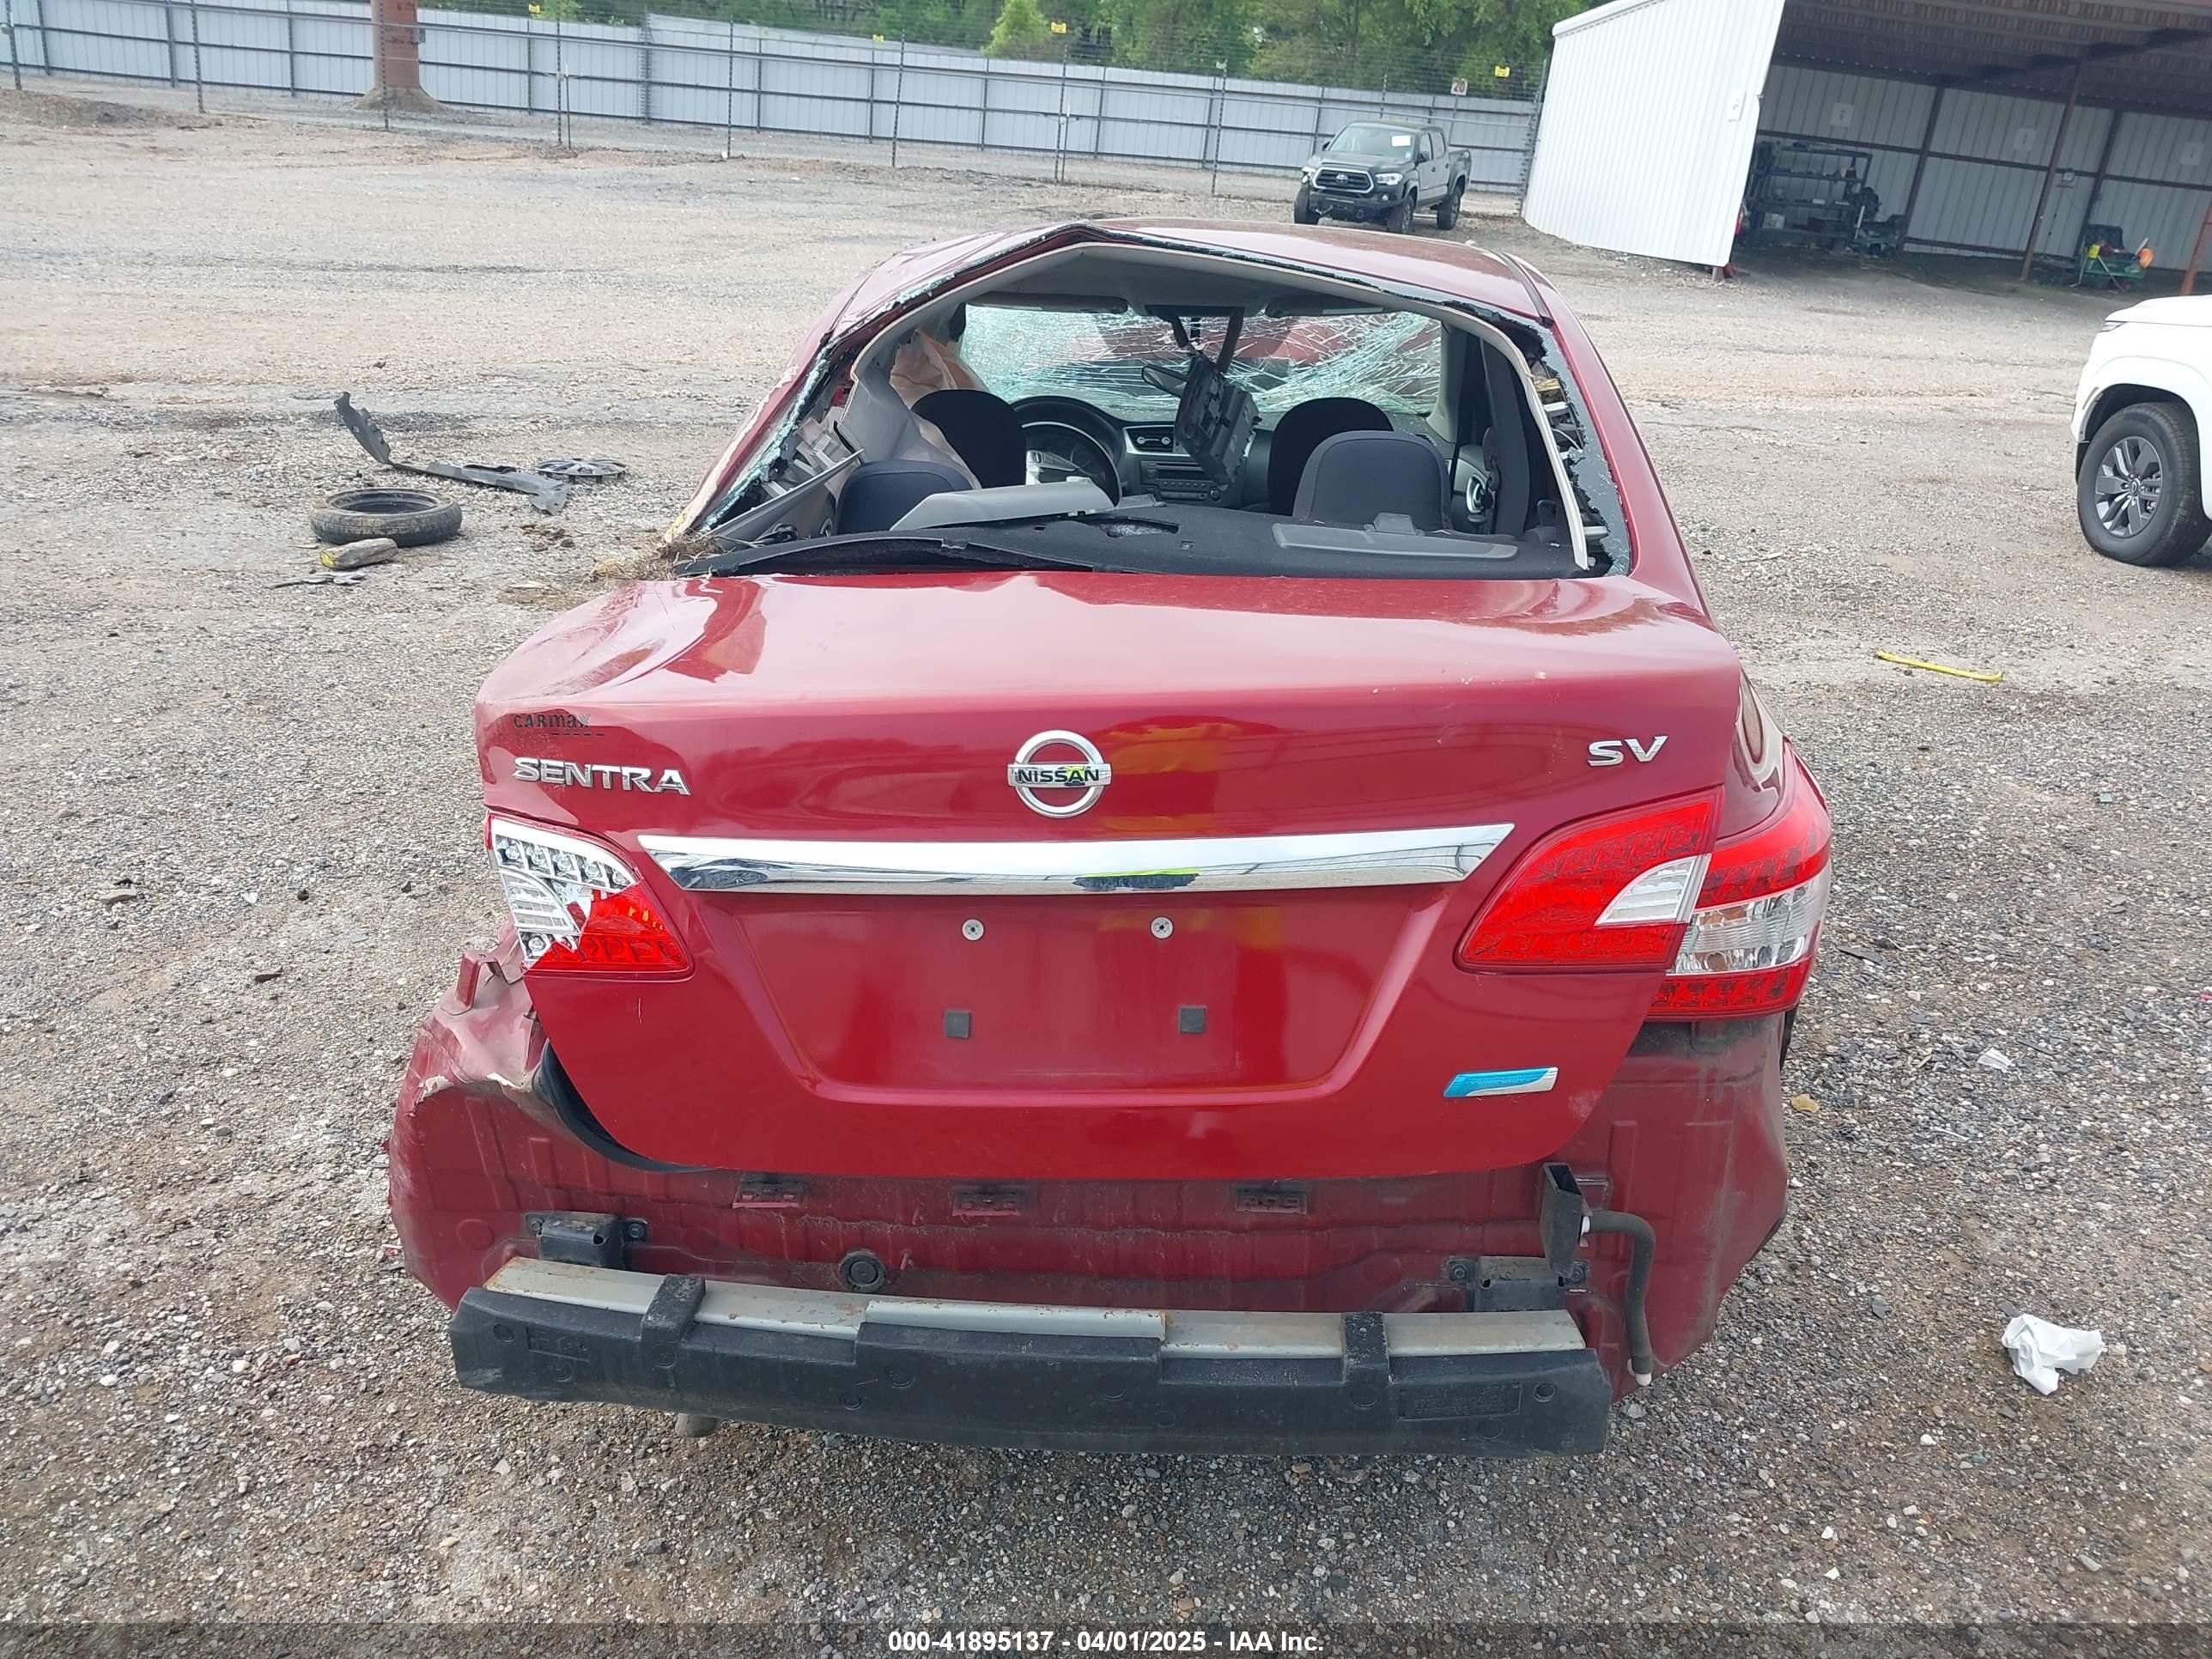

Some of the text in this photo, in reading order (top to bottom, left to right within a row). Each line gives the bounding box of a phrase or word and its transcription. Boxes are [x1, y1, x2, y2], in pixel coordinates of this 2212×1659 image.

[1453, 81, 1466, 93] 20
[1588, 736, 1668, 767] SV
[512, 756, 691, 796] SENTRA
[1017, 769, 1099, 783] NISSAN
